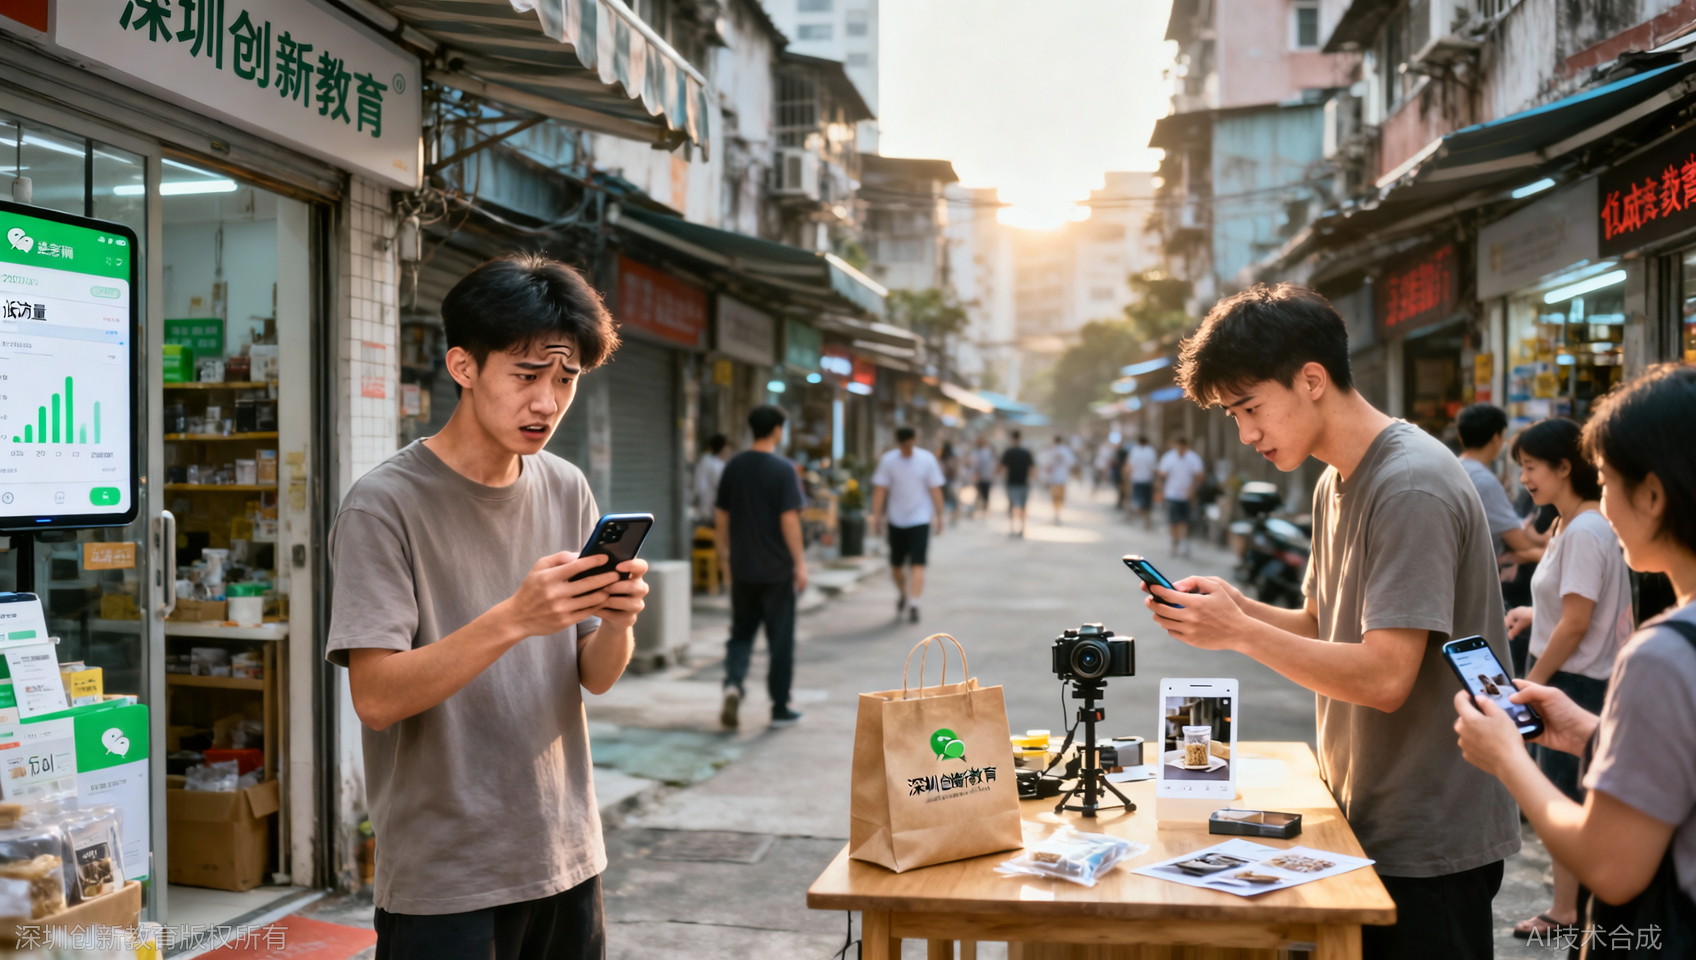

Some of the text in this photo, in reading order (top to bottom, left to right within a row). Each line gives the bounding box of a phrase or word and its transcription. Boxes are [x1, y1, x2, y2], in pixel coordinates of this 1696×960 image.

[119, 0, 388, 138] 深圳创新教育
